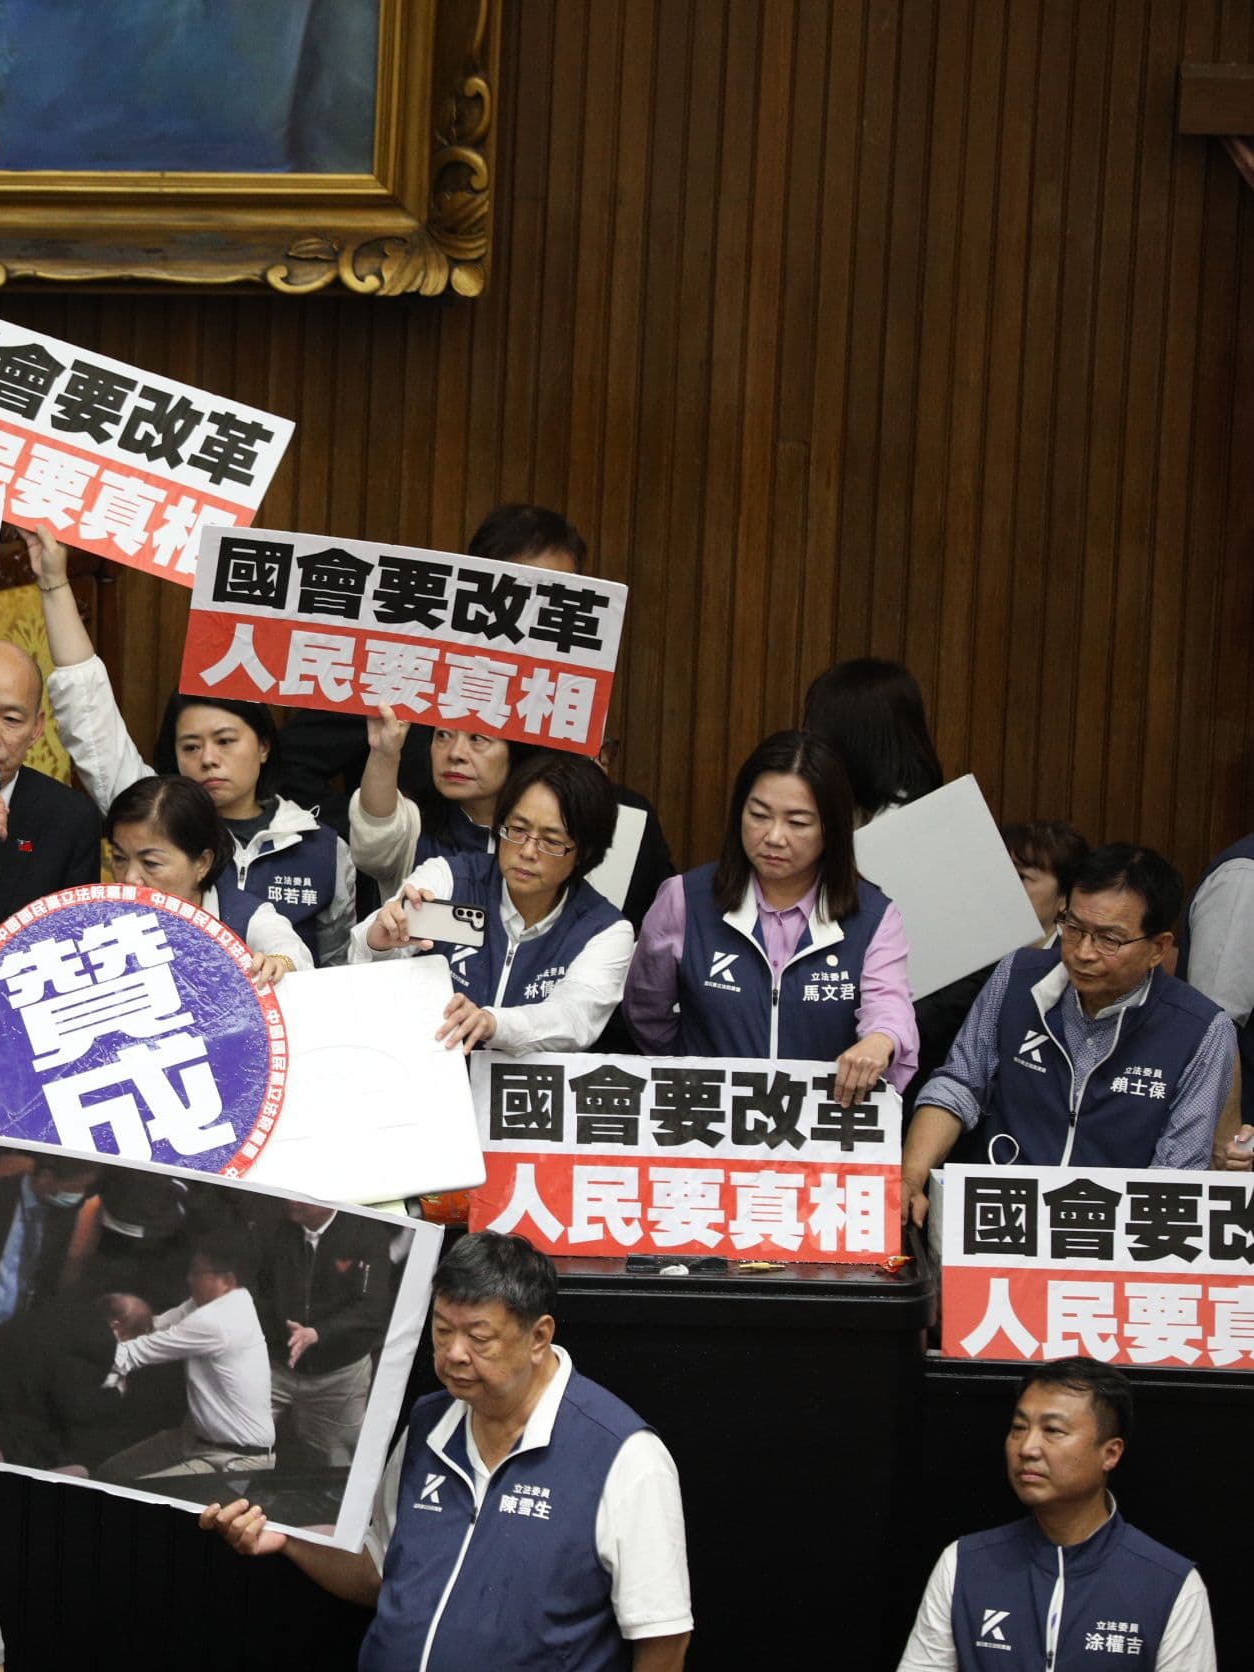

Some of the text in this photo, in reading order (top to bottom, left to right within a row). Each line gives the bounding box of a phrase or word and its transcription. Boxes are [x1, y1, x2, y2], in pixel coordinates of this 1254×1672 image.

[212, 536, 610, 655] 國會要改革
[200, 624, 597, 744] 人民要真相
[274, 876, 312, 887] 立法委員
[267, 886, 318, 906] 邱若華
[811, 971, 850, 982] 立法委員
[802, 983, 856, 1002] 馬文君
[1123, 1066, 1163, 1079] 立法委員
[1110, 1076, 1167, 1100] 賴士葆
[490, 1063, 887, 1152] 國會要改革
[486, 1163, 886, 1254] 人民要真相
[513, 1483, 551, 1499] 立法委員
[498, 1494, 553, 1520] 陳雪生
[1096, 1621, 1139, 1634] 立法委員
[1084, 1632, 1144, 1655] 涂權吉
